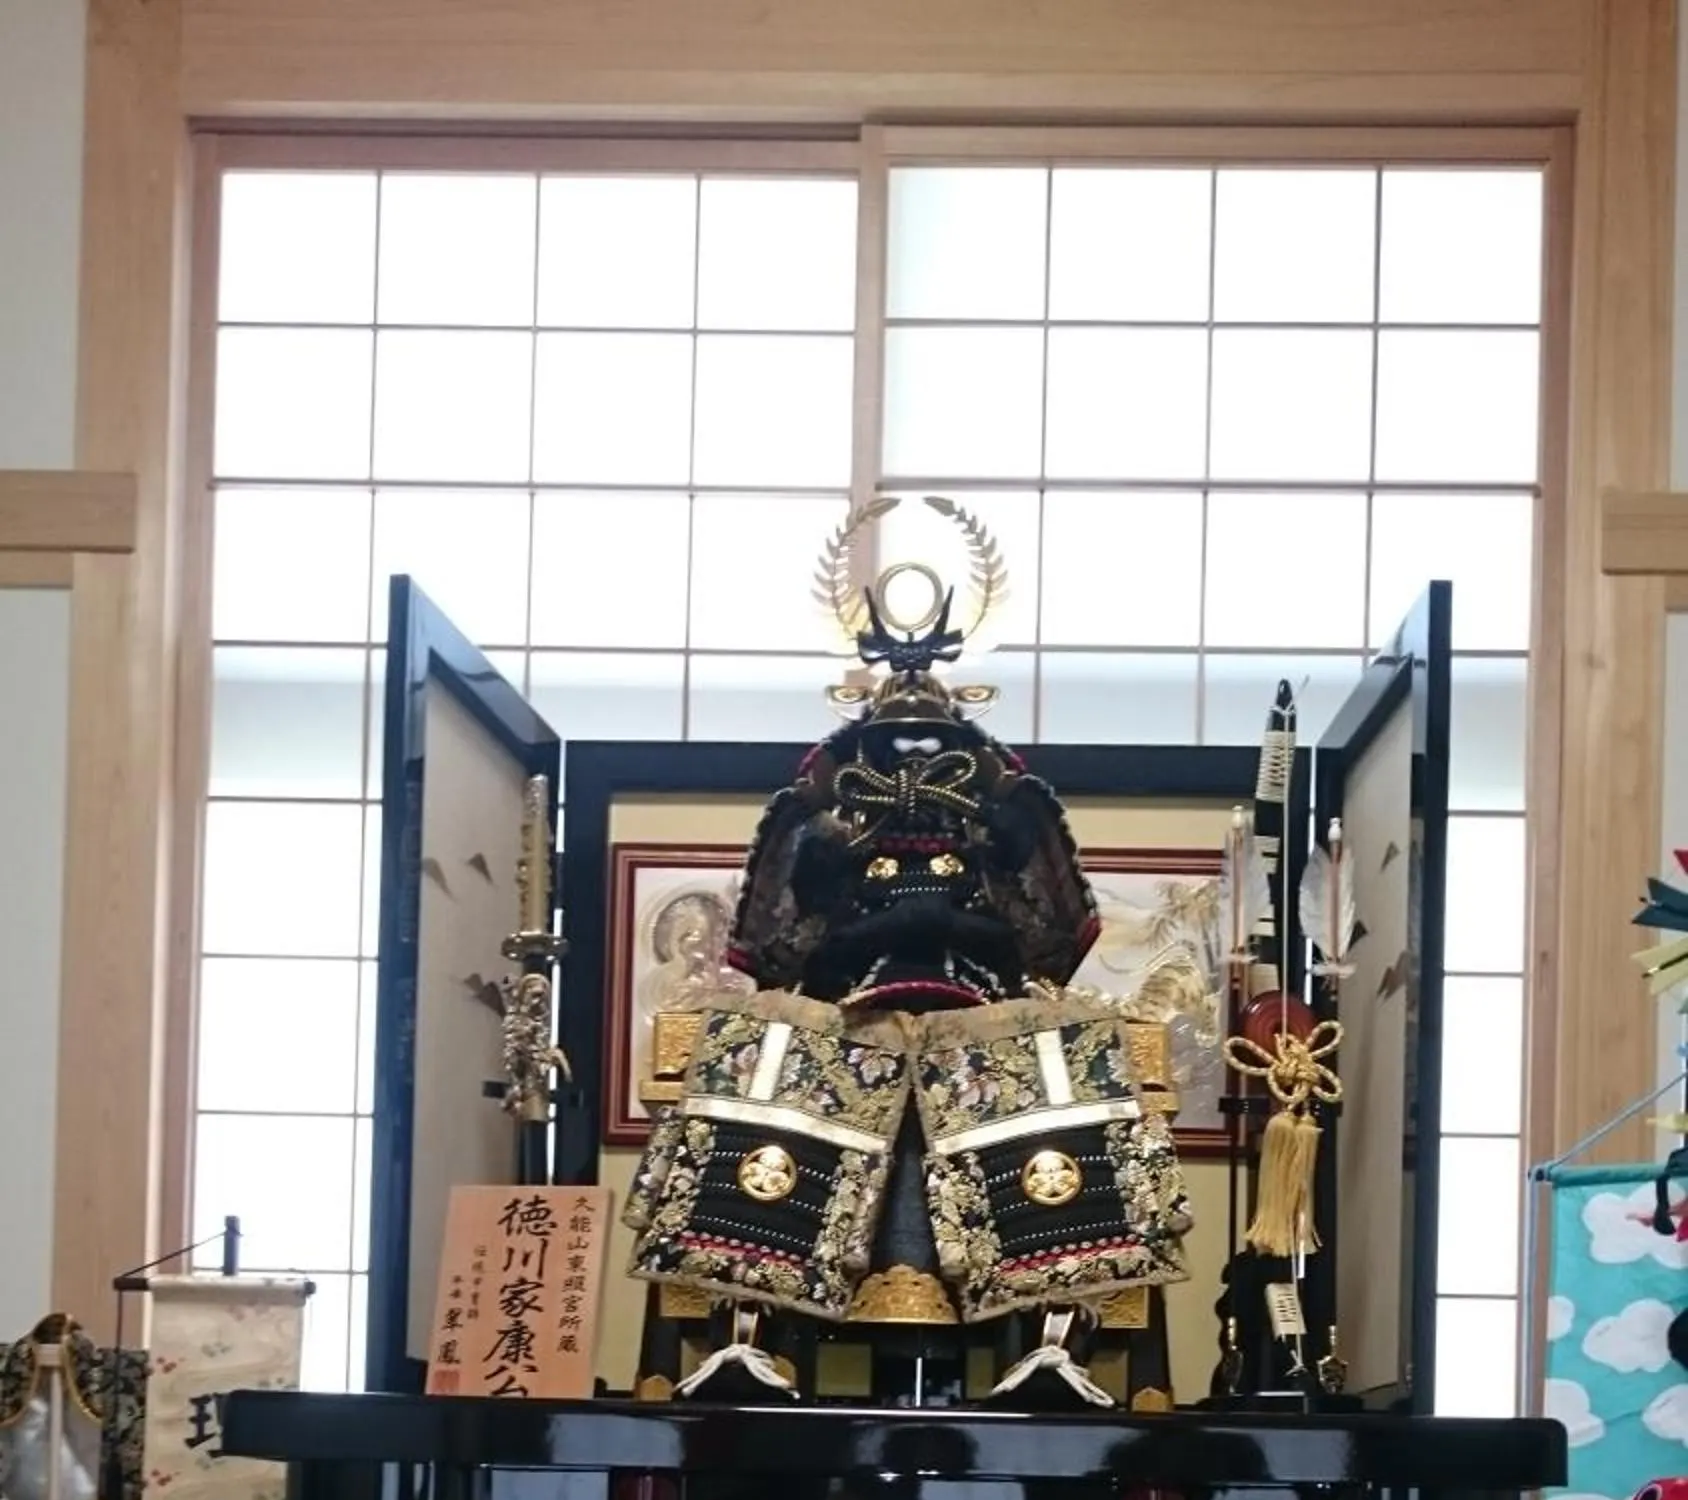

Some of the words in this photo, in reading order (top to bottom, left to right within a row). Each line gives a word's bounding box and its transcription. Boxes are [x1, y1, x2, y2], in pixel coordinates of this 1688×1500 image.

[483, 1195, 557, 1397] 徳川家康公
